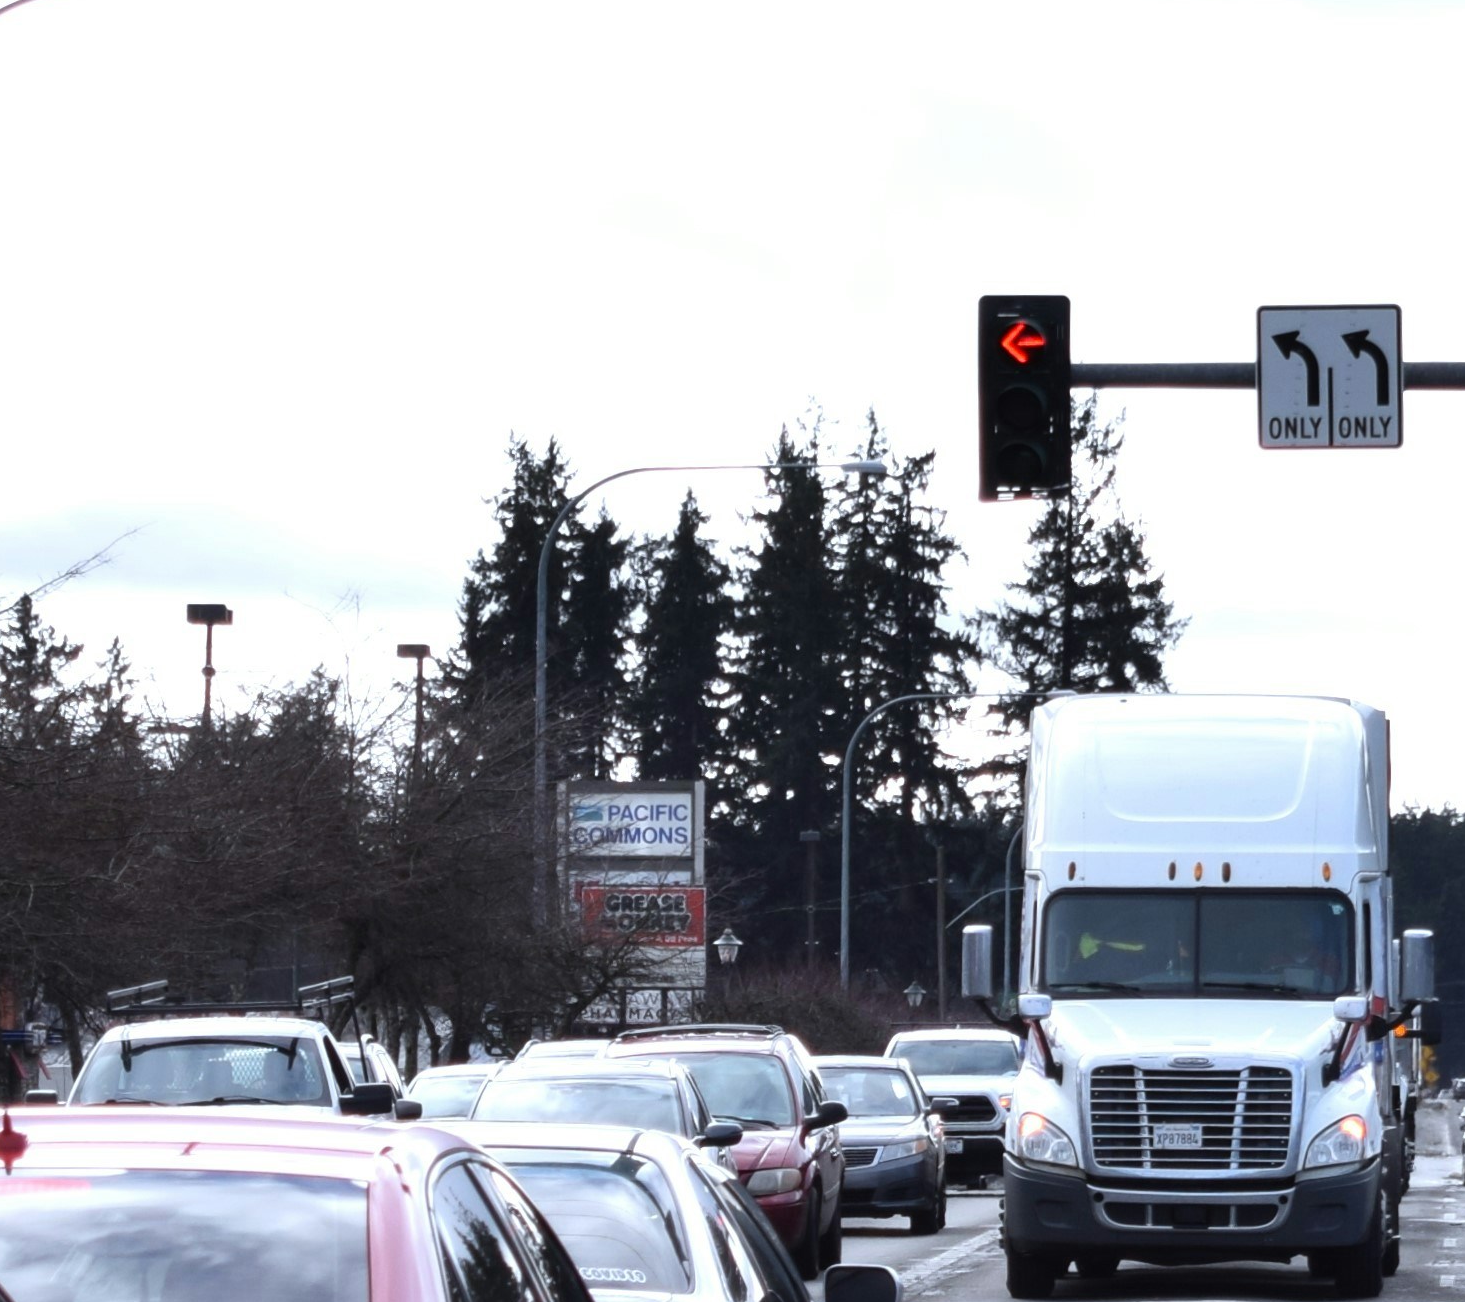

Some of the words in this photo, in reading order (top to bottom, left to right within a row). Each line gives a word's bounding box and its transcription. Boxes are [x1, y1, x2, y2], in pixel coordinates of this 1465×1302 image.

[1268, 417, 1322, 439] ONLY
[1338, 416, 1392, 438] ONLY
[608, 804, 688, 822] PACIFIC
[574, 827, 688, 844] COMMONS
[605, 893, 687, 914] GREASE
